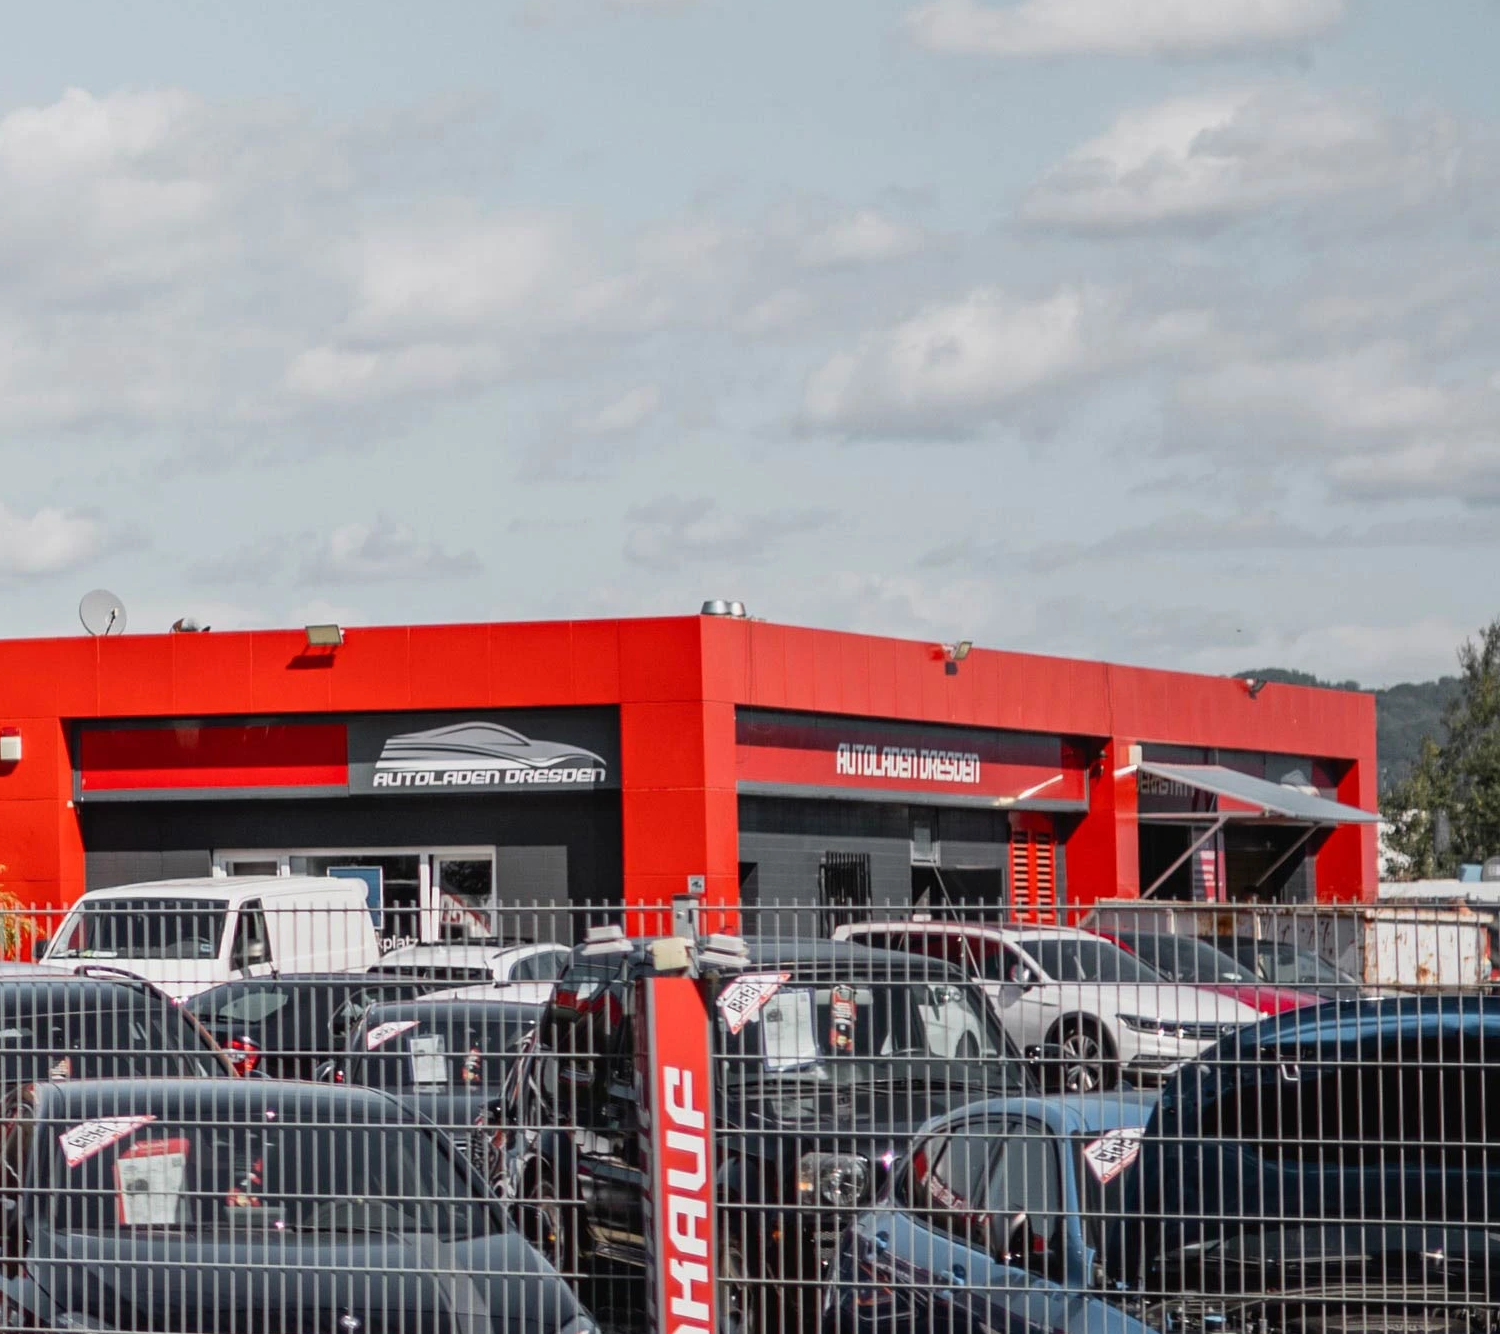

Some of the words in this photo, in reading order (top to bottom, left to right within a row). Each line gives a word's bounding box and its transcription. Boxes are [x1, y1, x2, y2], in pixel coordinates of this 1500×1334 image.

[373, 769, 500, 787] AUTOLADEN
[505, 768, 607, 784] DRESDEN
[836, 742, 918, 779] AUTOLADEN
[920, 748, 980, 784] DRESDEN
